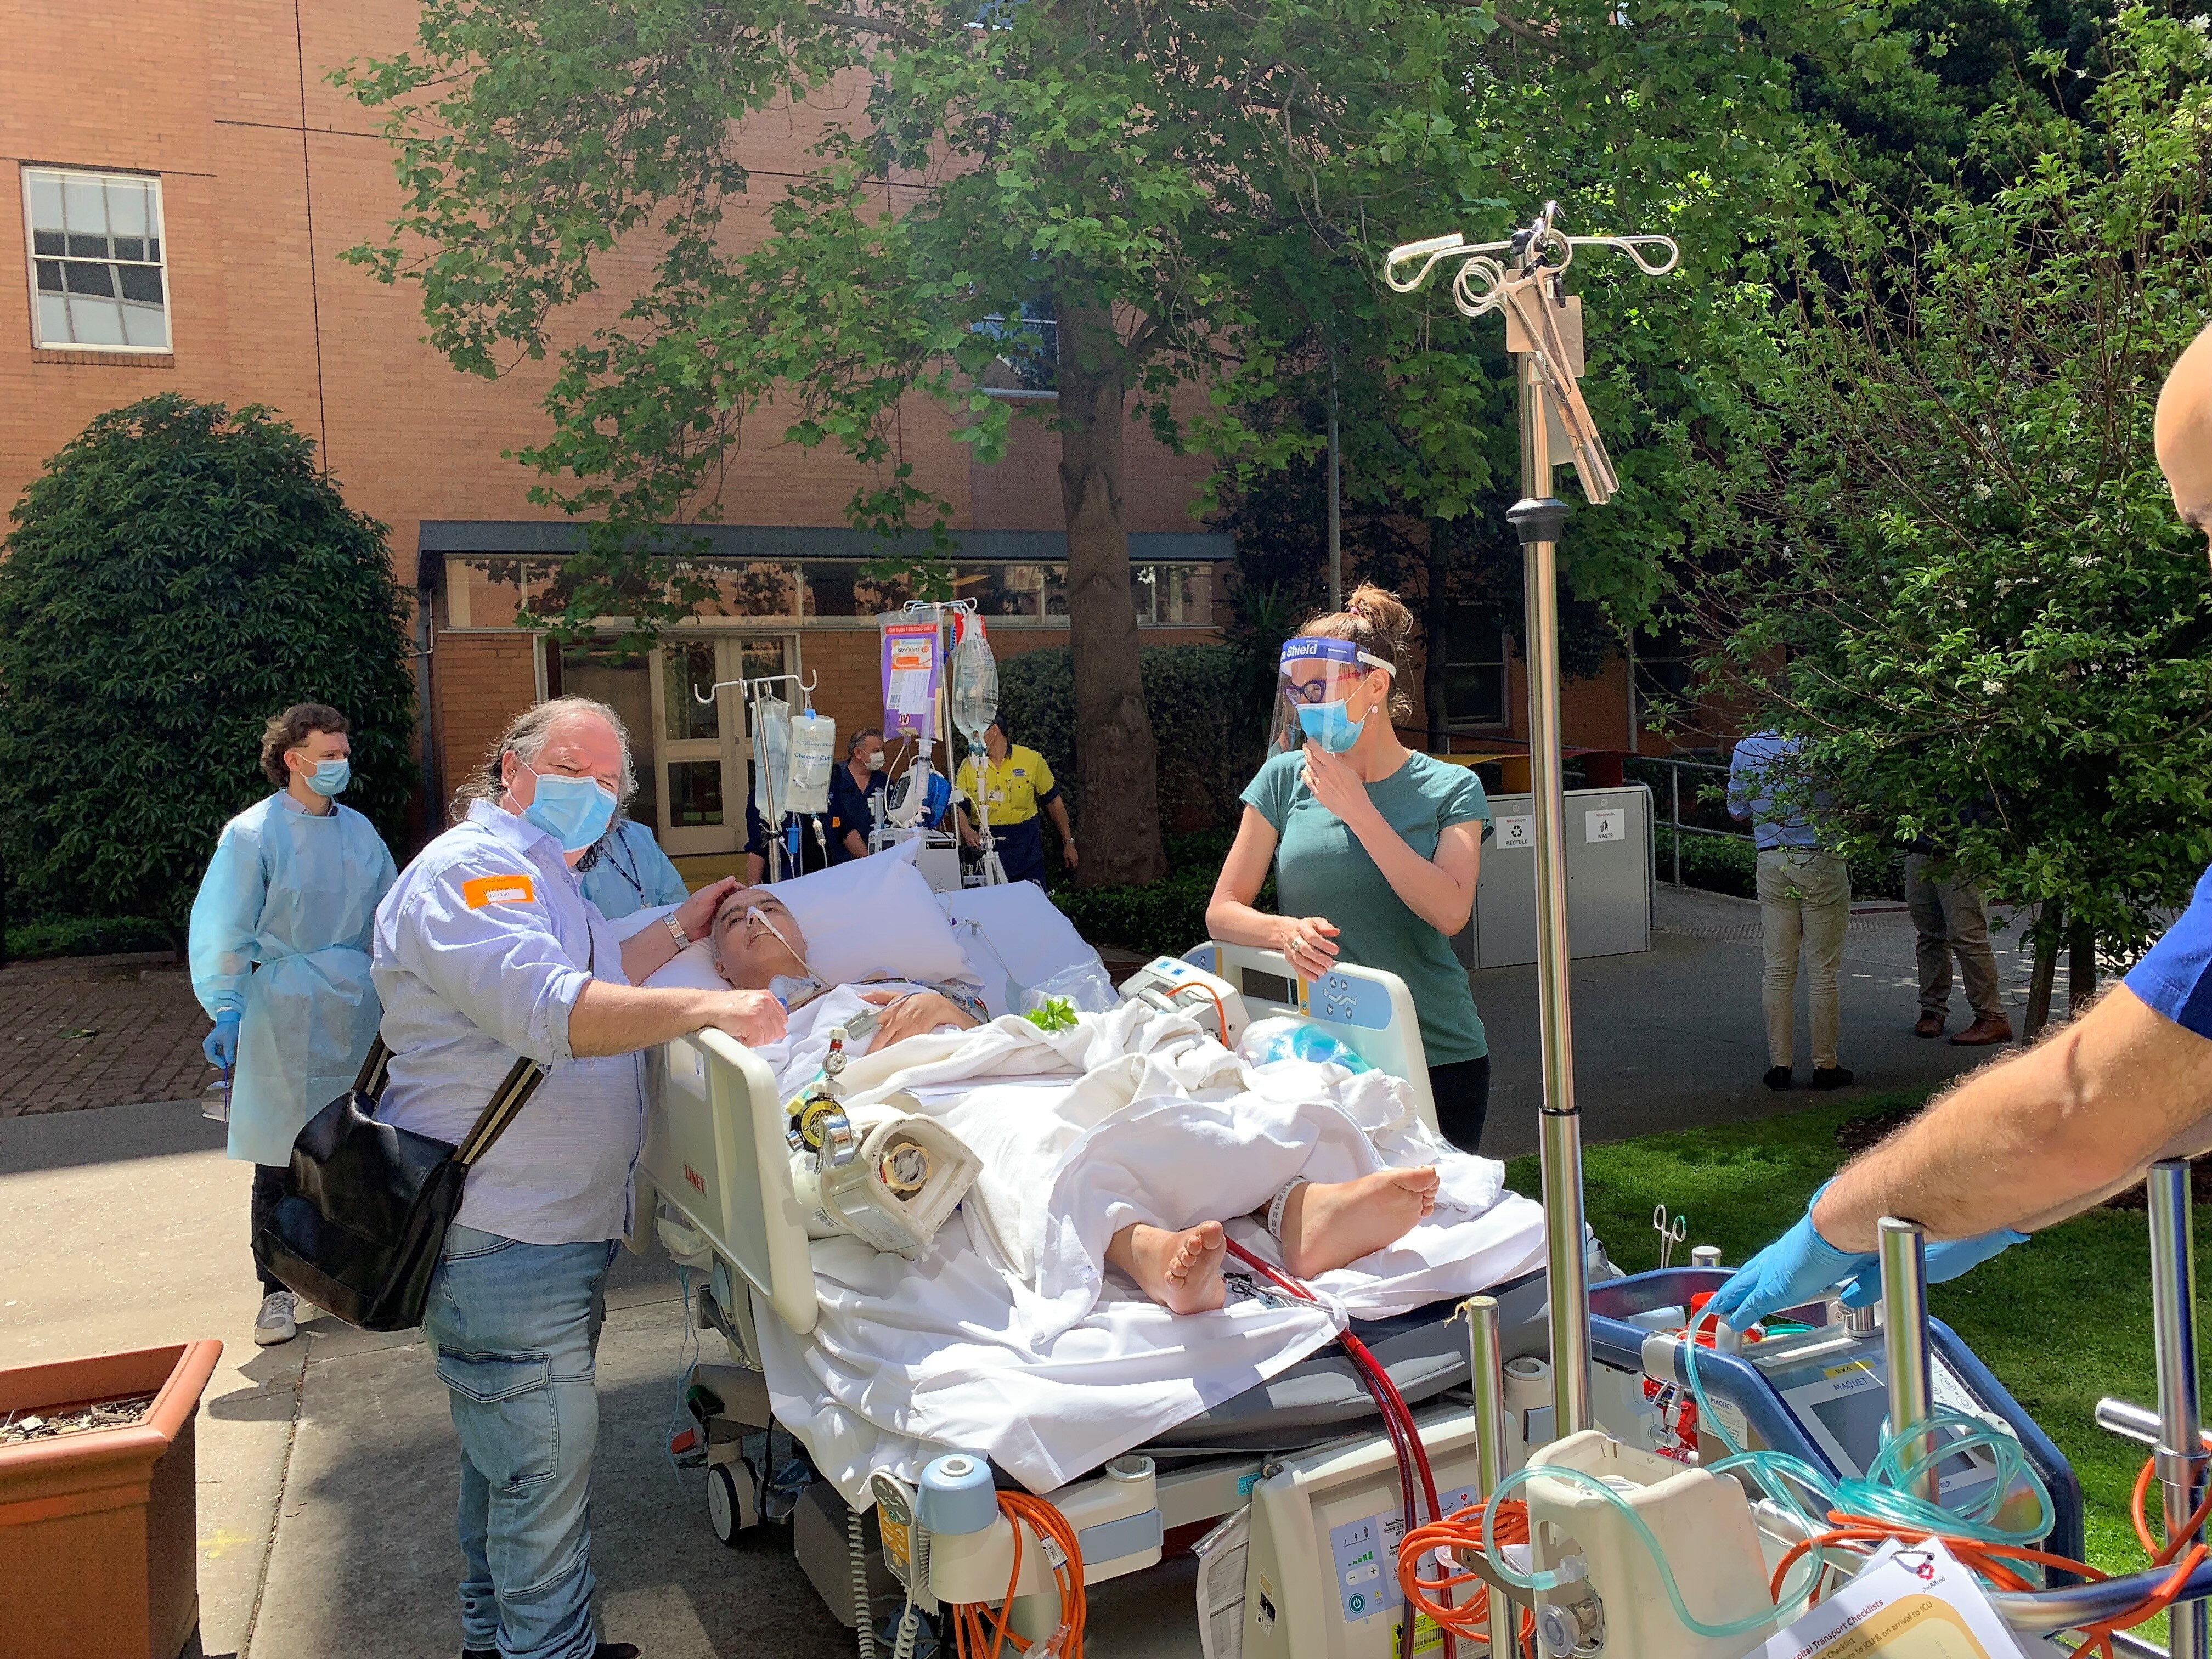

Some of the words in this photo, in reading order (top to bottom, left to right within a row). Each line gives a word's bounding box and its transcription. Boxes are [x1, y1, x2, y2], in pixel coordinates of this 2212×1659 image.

[1287, 644, 1318, 657] Shield
[685, 1164, 706, 1194] LINET
[1833, 1377, 1867, 1391] MAQUET
[1711, 1397, 1733, 1410] MAQUET
[1922, 1575, 1946, 1593] theAlfred
[1812, 1622, 1848, 1649] Transport
[1847, 1600, 1884, 1626] Checklists
[1863, 1638, 1875, 1649] ICU
[1882, 1629, 1892, 1637] on
[1891, 1613, 1912, 1631] arrival
[1912, 1610, 1920, 1618] to
[1920, 1601, 1933, 1612] ICU
[1827, 1638, 1855, 1659] Checklist
